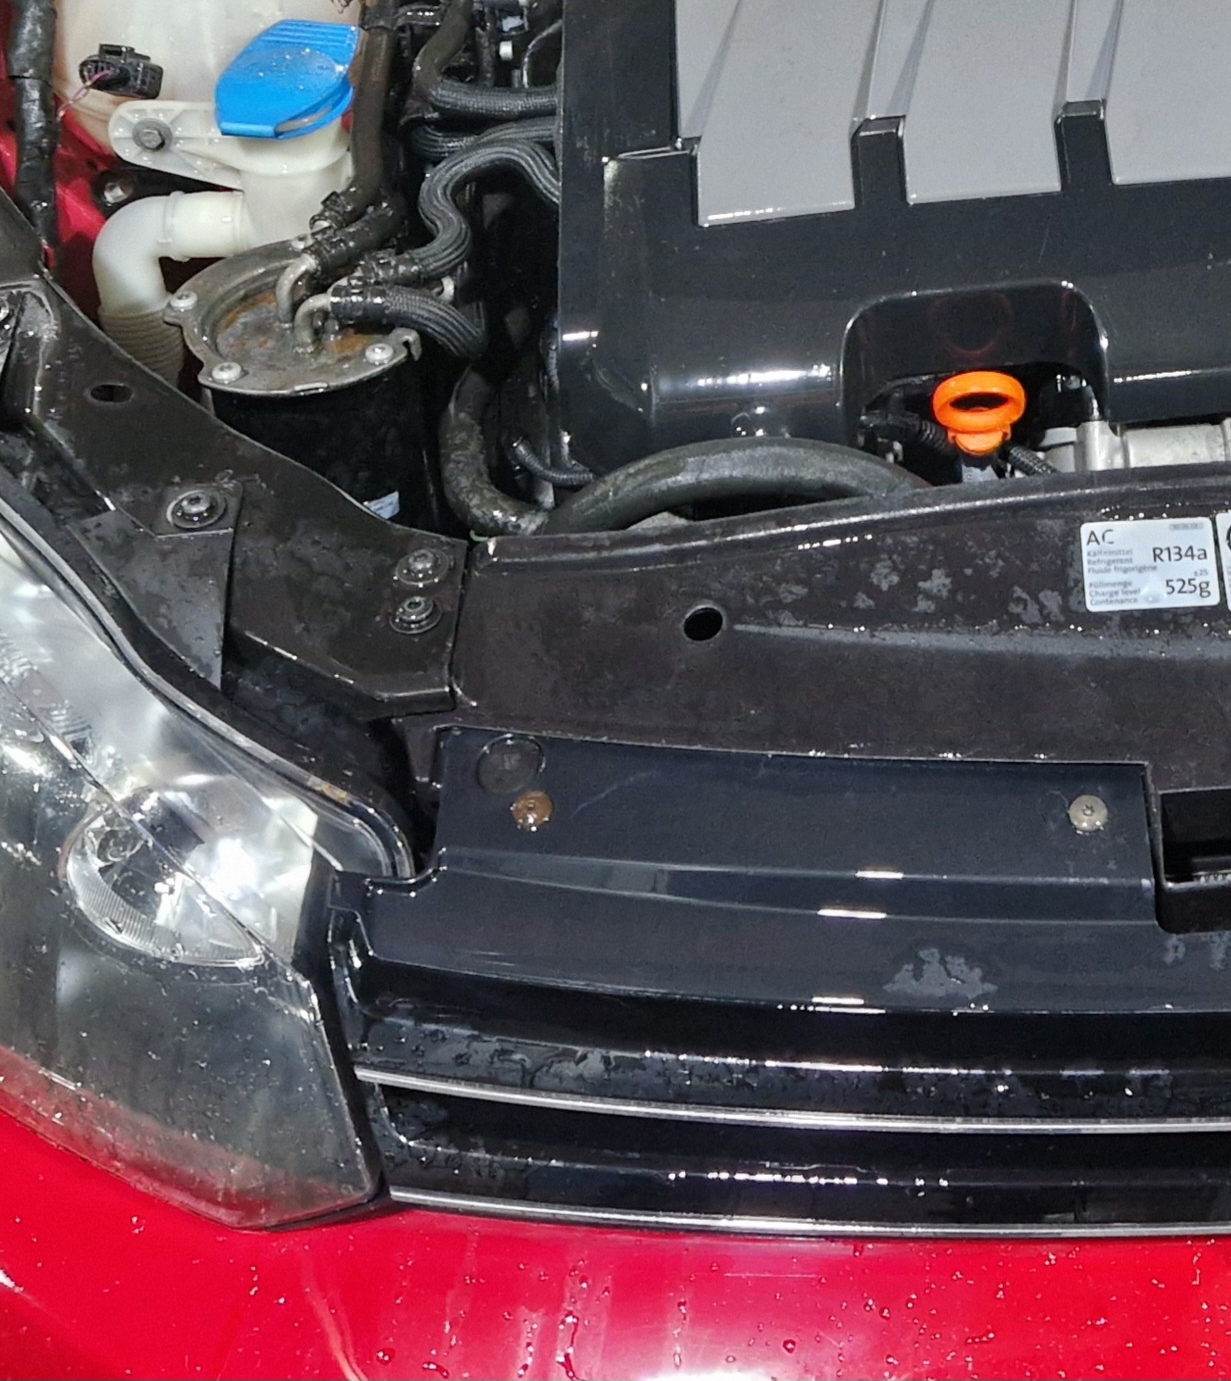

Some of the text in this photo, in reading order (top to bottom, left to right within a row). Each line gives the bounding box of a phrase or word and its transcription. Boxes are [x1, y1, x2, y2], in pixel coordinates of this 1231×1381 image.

[1086, 529, 1115, 546] AC
[1152, 545, 1208, 563] R134a
[1089, 588, 1141, 598] Charge level
[1165, 578, 1212, 598] 525g
[1090, 597, 1139, 606] Contenance
